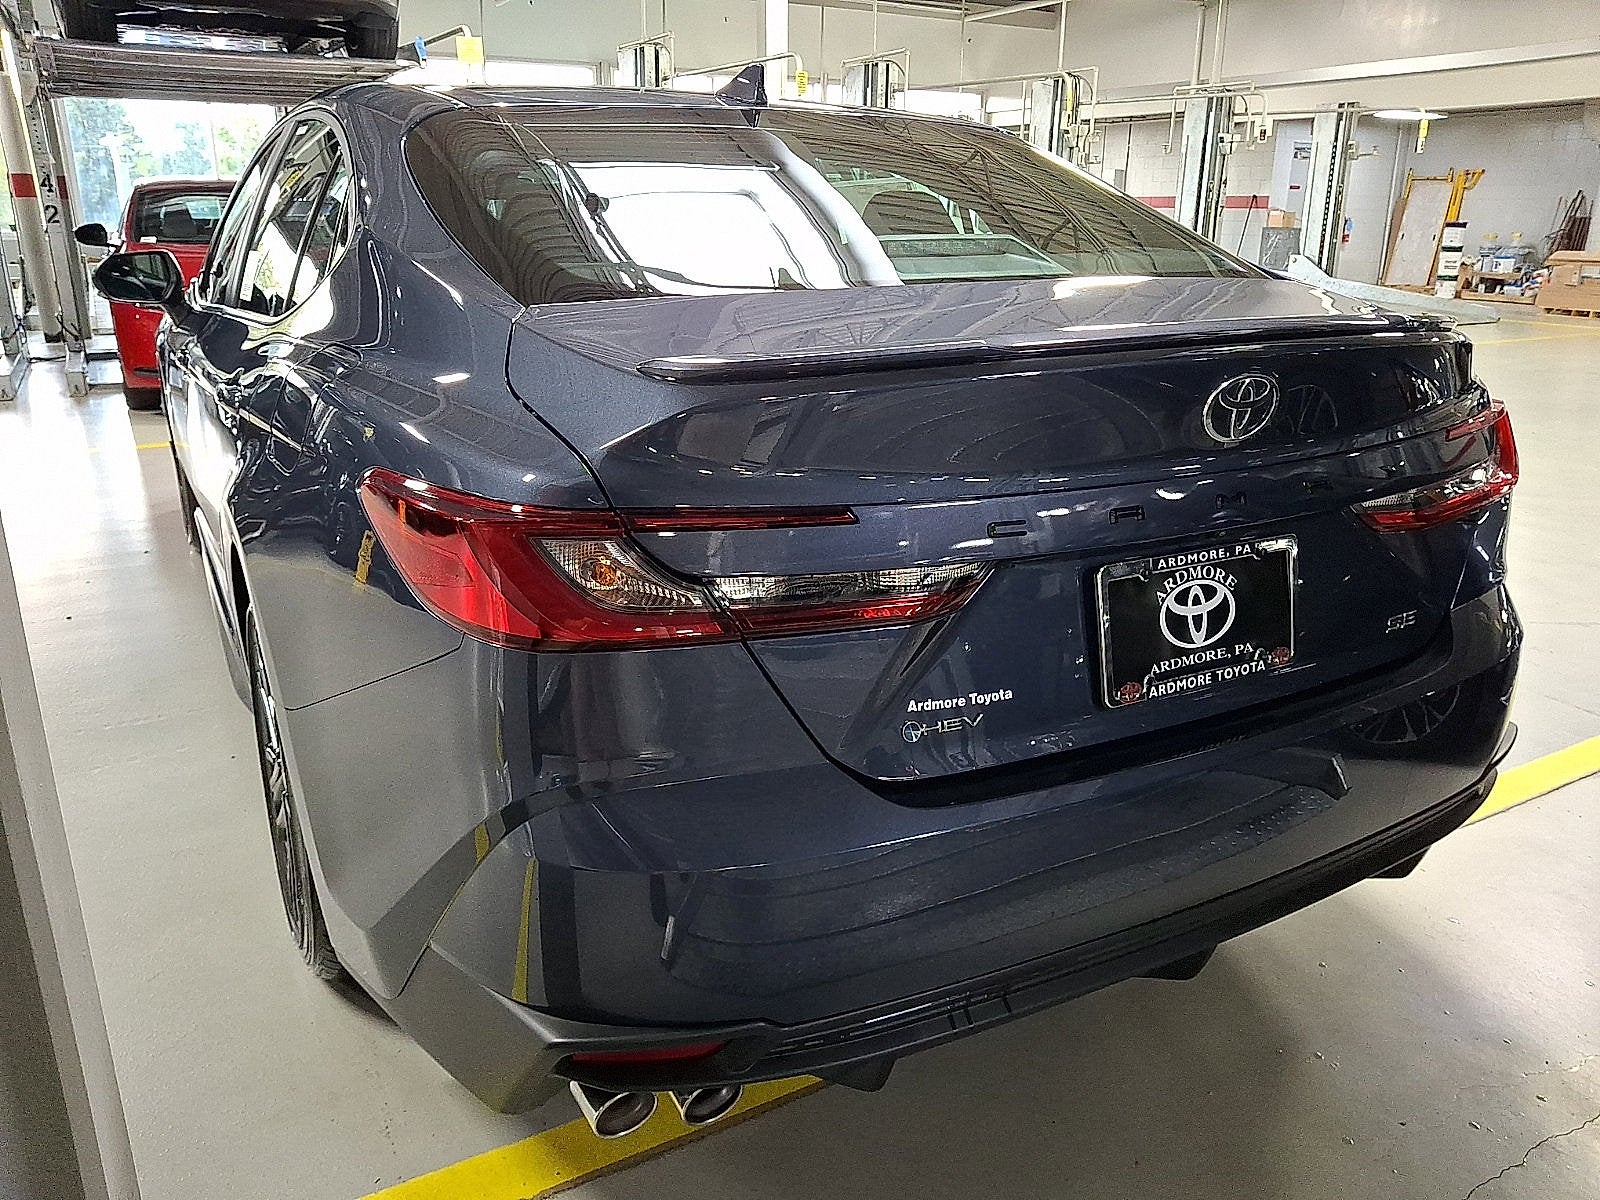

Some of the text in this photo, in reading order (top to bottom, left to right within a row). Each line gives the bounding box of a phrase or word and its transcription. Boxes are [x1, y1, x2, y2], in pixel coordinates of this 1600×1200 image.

[1157, 543, 1252, 570] ARDMORE, PA
[1156, 565, 1238, 607] ARDMORE
[1149, 641, 1254, 676] ARDMORE, PA
[1149, 659, 1266, 699] ARDMORE TOYOTA
[907, 688, 1013, 713] Ardmore Toyota
